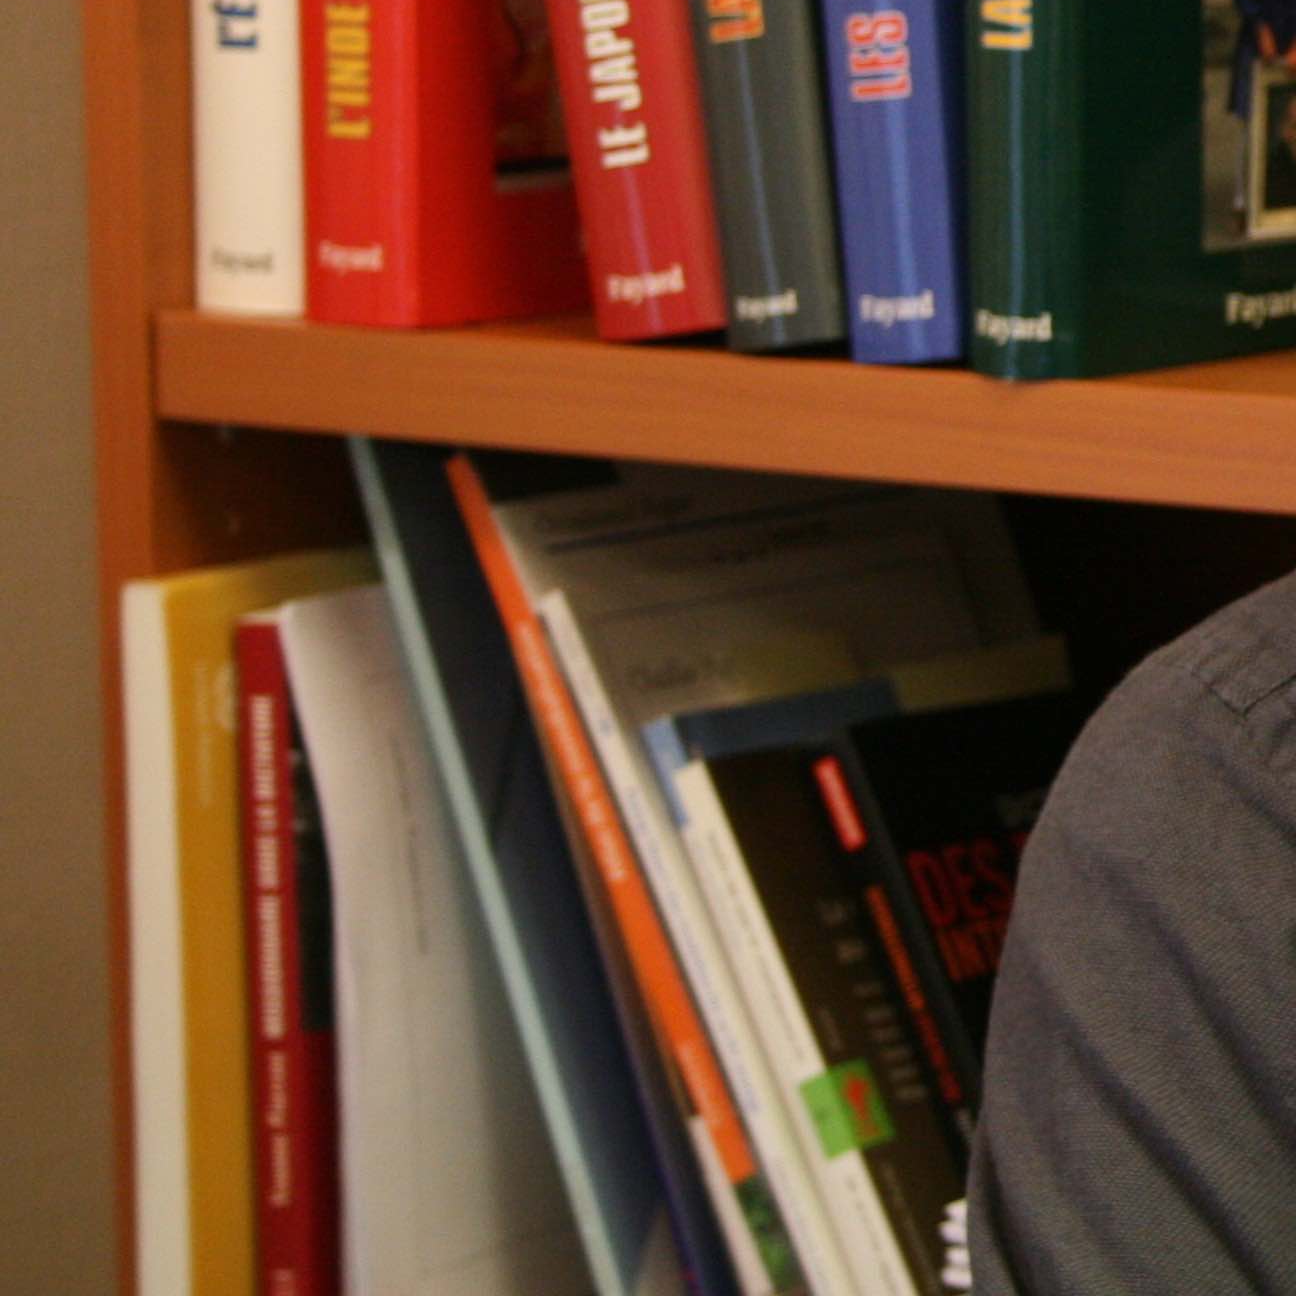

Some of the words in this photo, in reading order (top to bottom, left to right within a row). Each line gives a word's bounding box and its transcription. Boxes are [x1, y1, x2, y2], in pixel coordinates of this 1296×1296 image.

[325, 2, 372, 140] L'INDE
[844, 8, 913, 103] LES
[596, 122, 650, 170] LE
